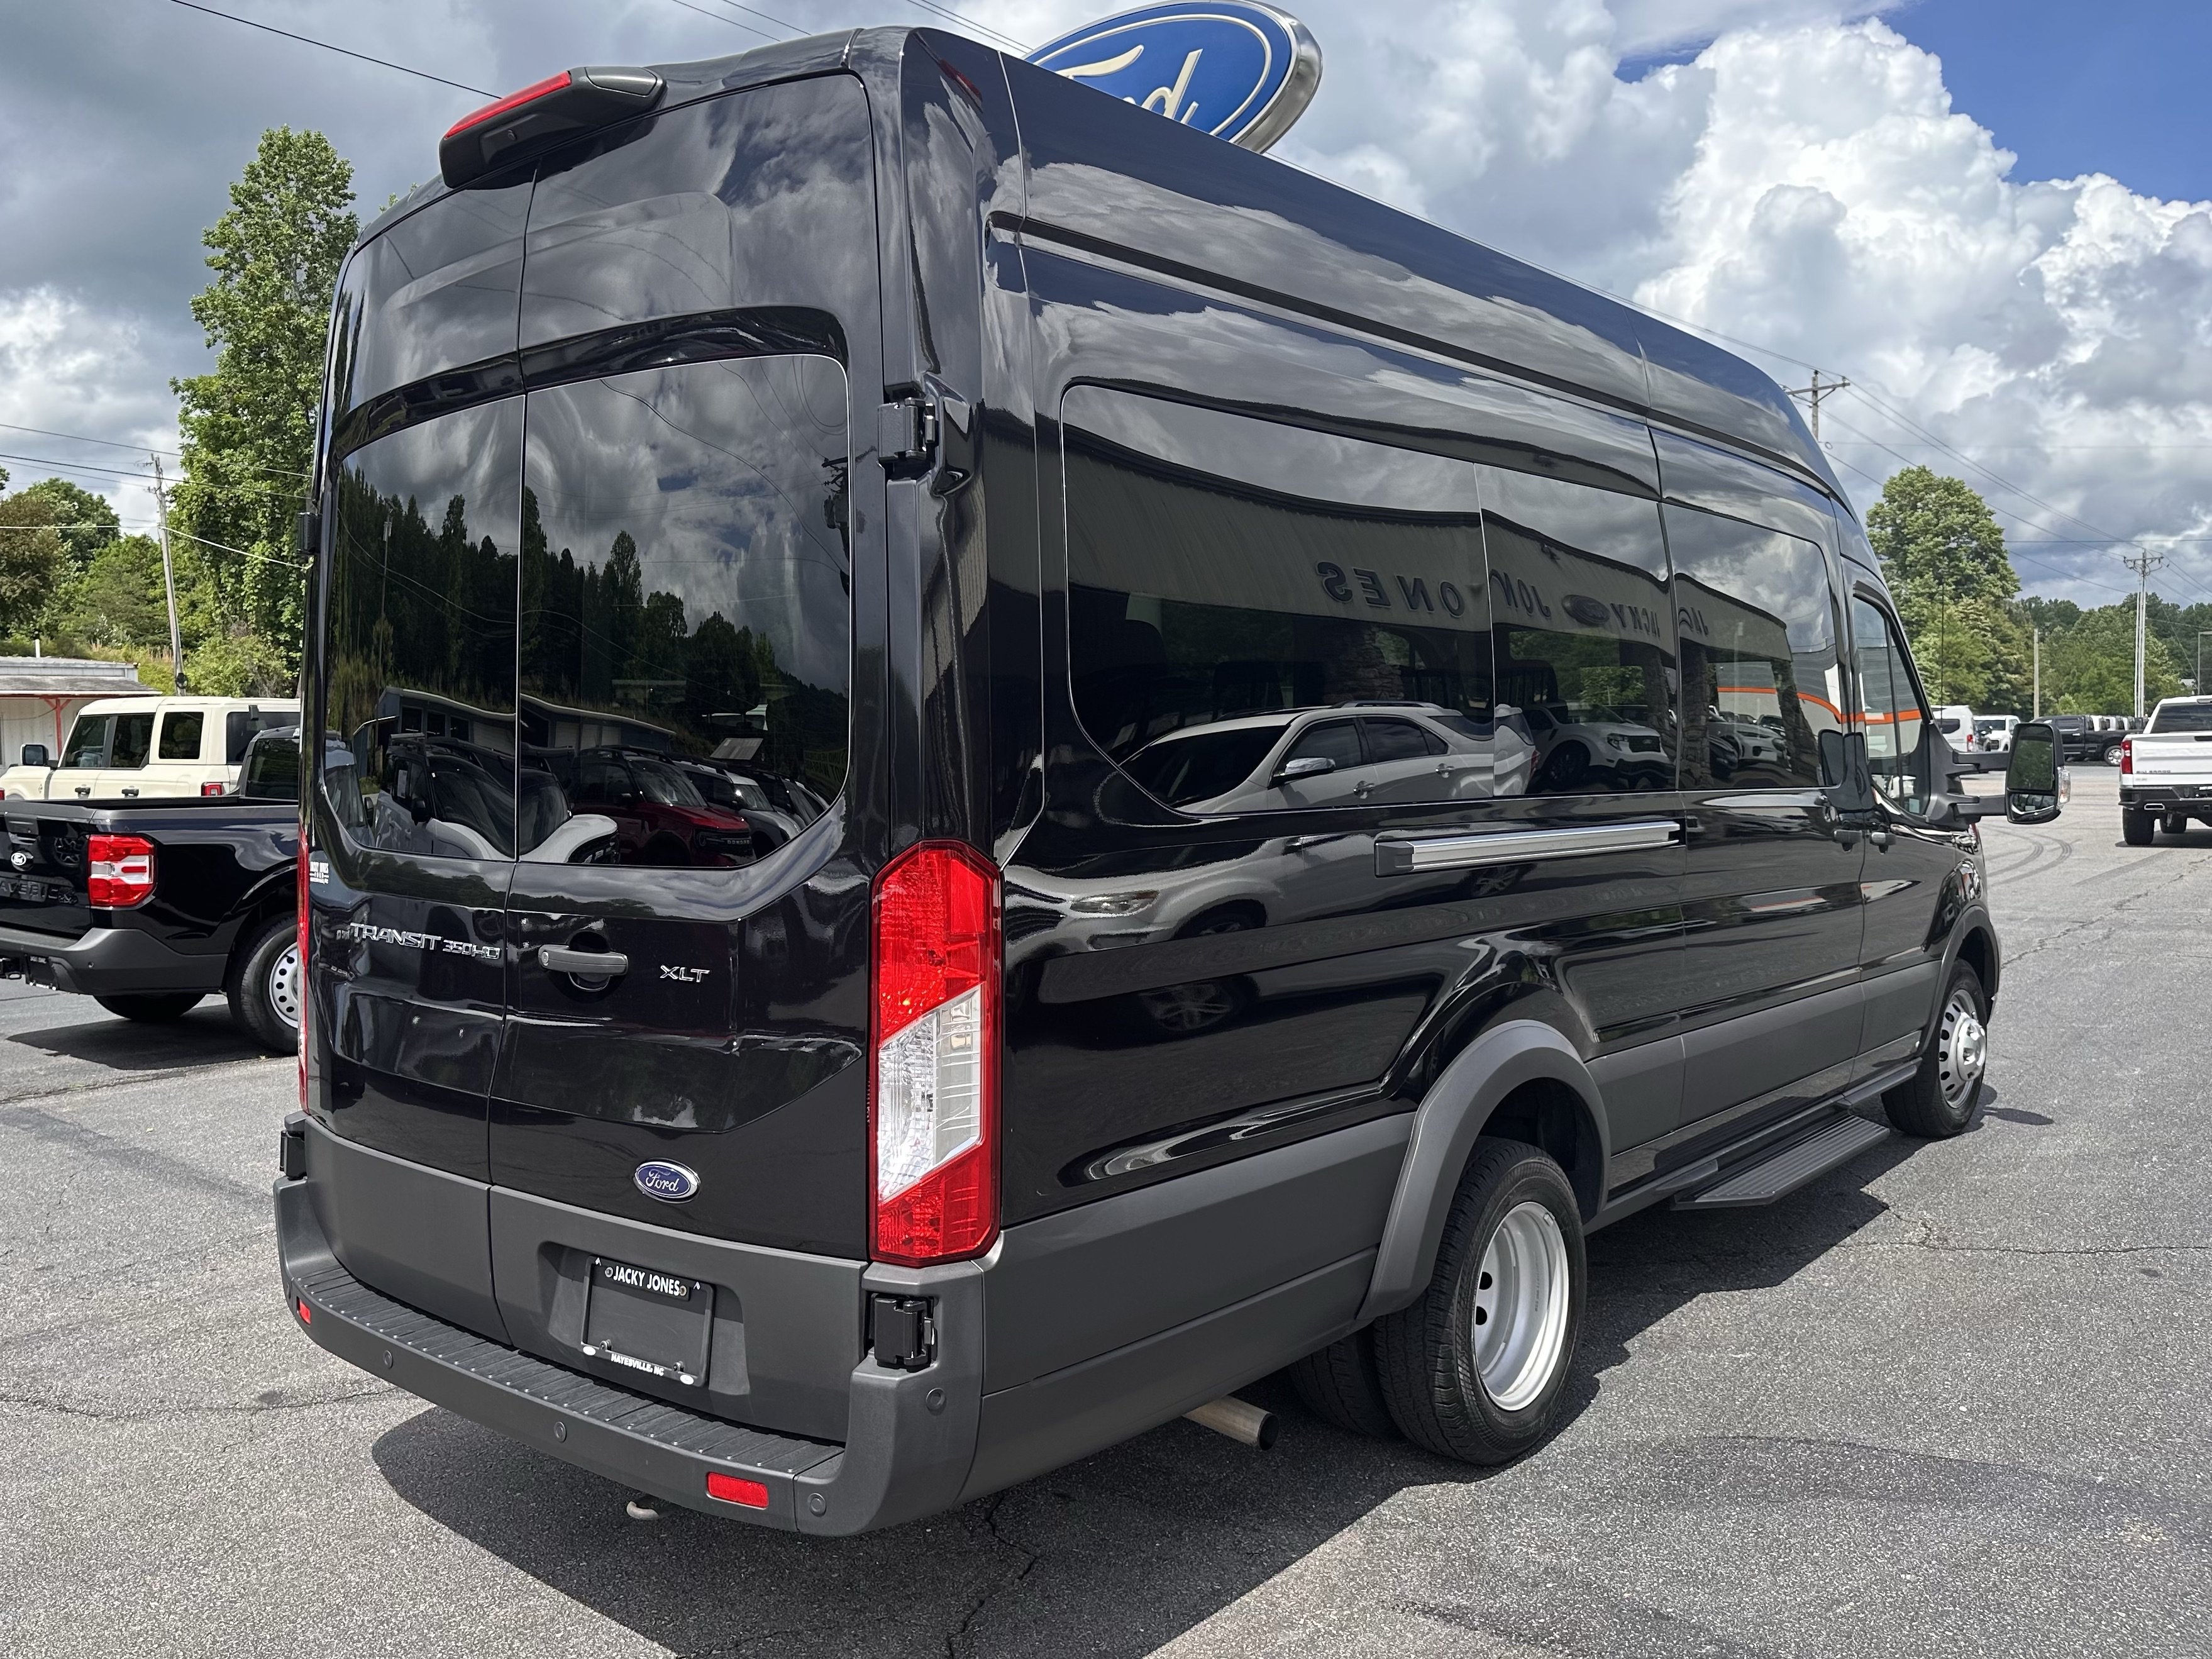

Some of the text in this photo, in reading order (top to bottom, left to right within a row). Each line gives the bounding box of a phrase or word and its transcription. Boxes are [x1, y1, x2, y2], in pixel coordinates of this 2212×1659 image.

[350, 922, 442, 950] TRANSIT
[443, 939, 501, 960] 350HD
[660, 965, 711, 983] XLT
[645, 1168, 680, 1192] Ford
[613, 1265, 680, 1296] JACKY JONES
[611, 1353, 664, 1377] HAYESVILLE, NC
